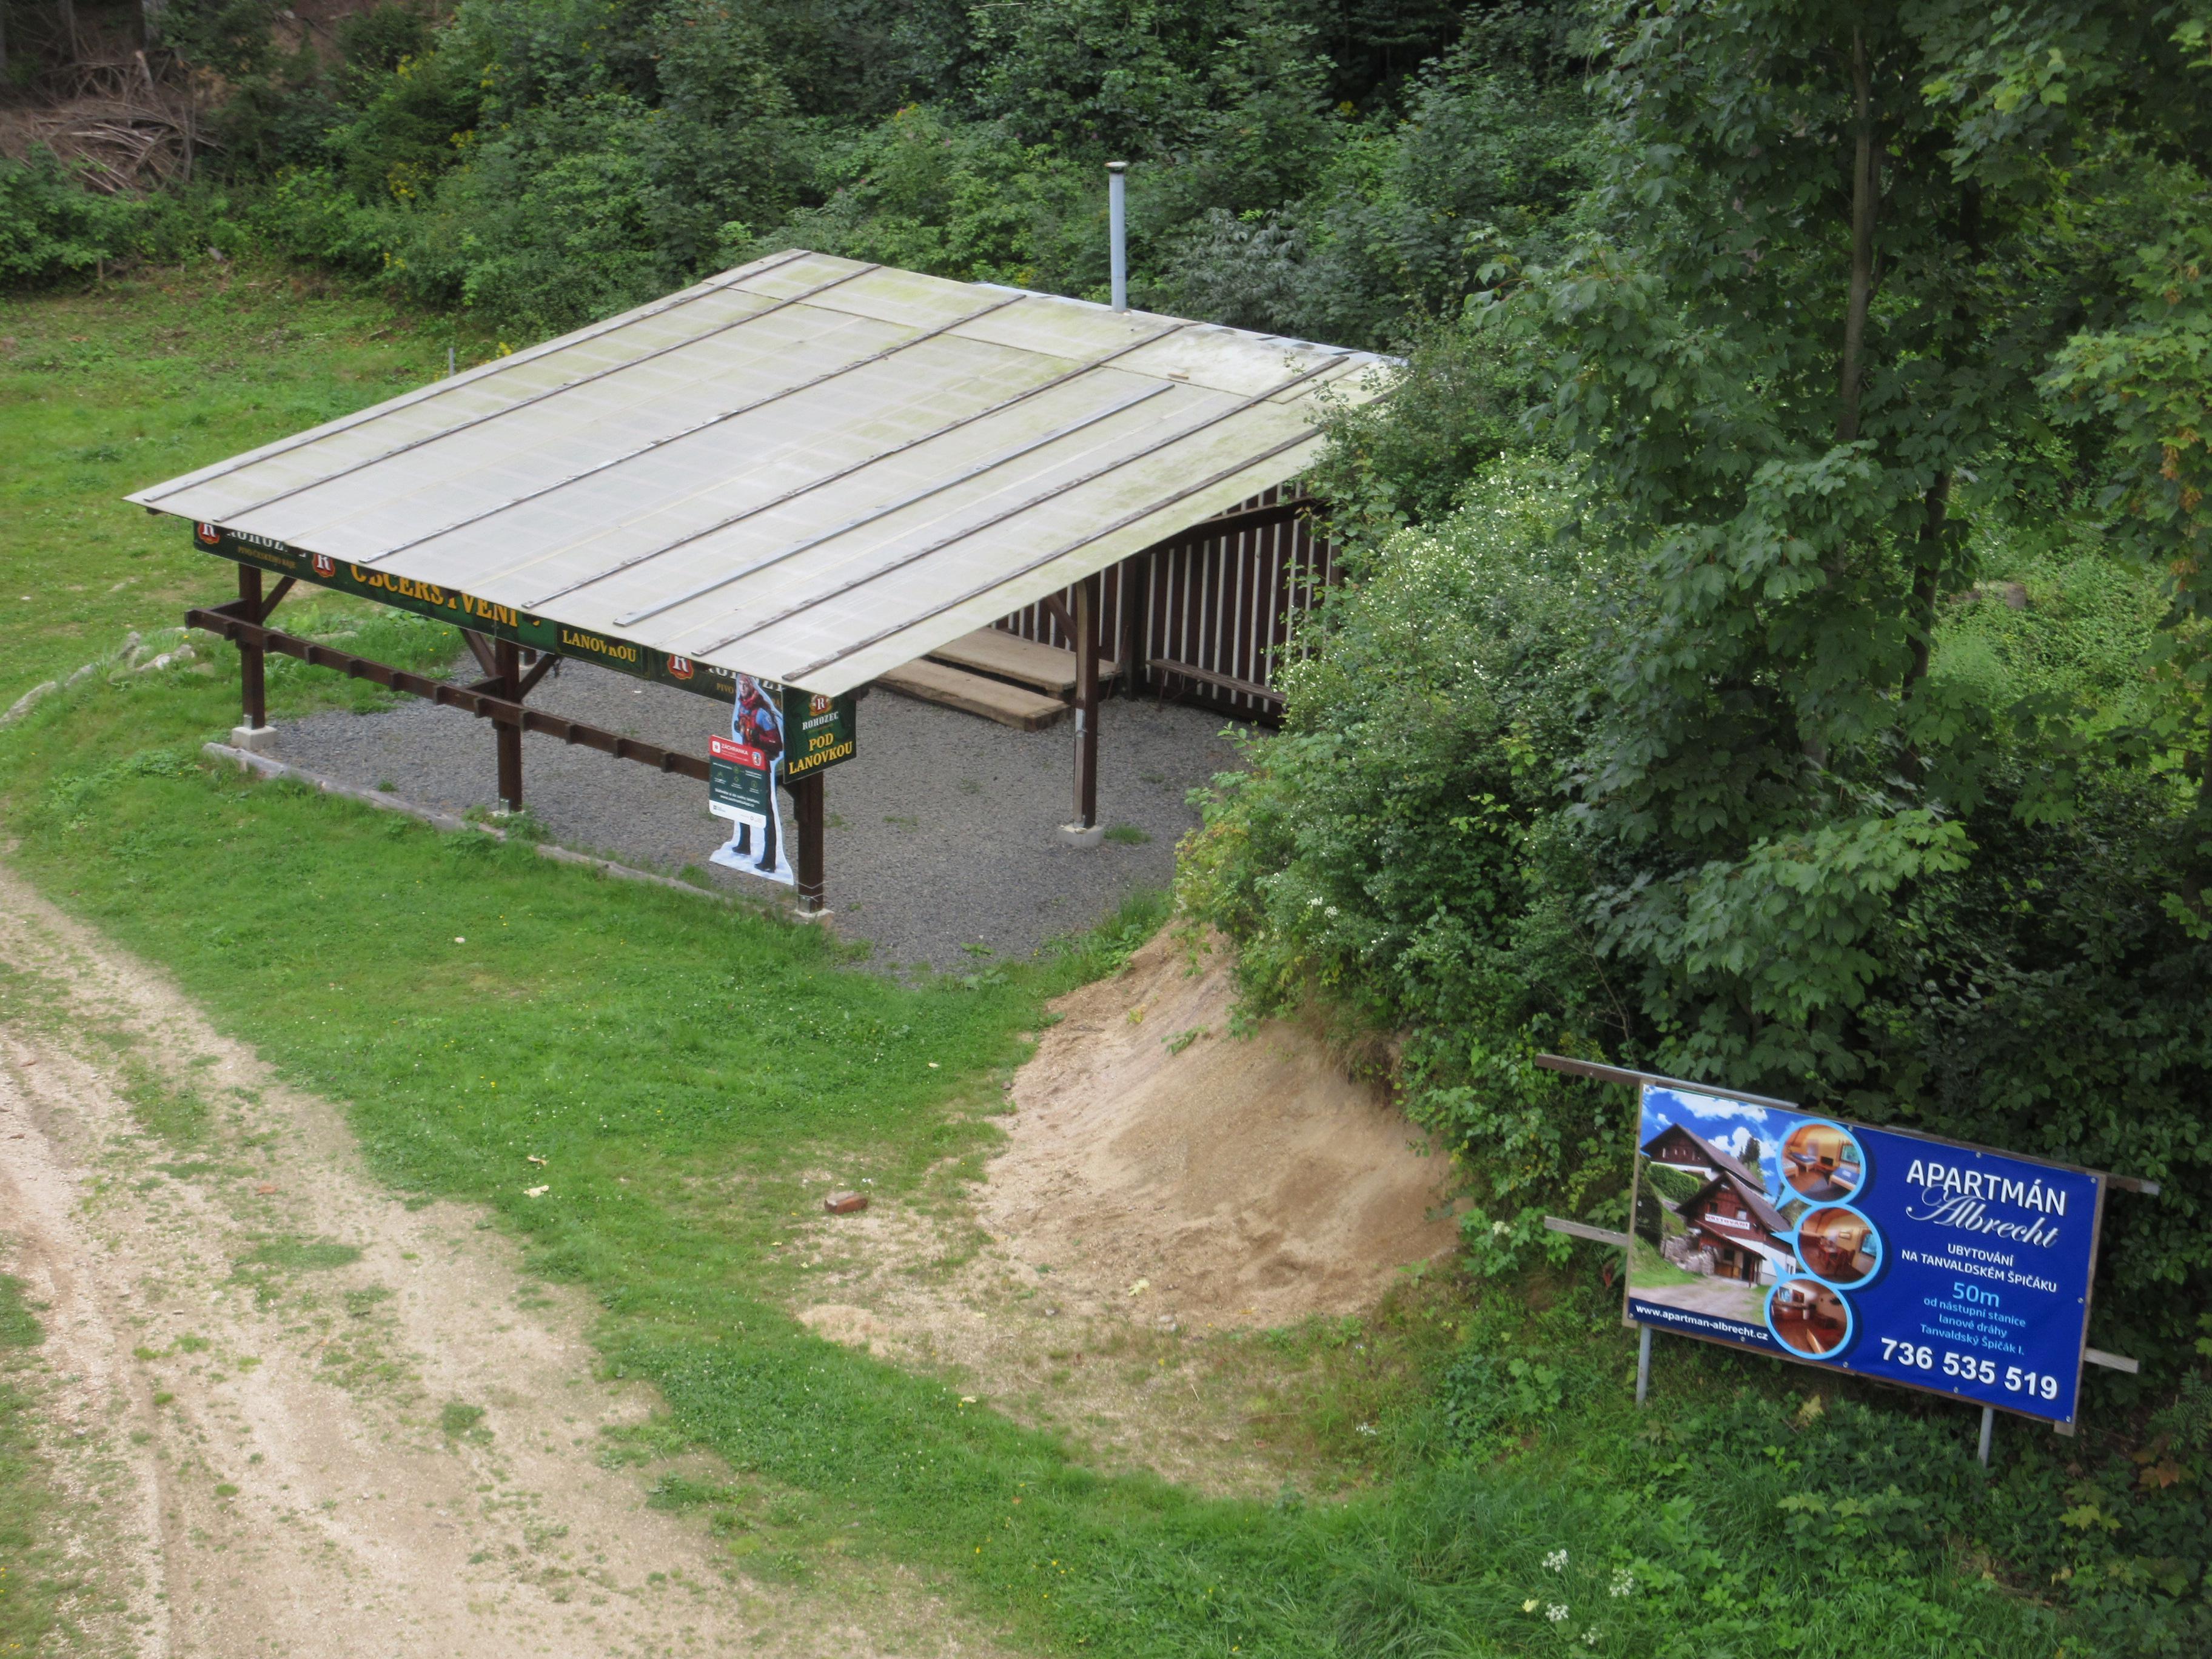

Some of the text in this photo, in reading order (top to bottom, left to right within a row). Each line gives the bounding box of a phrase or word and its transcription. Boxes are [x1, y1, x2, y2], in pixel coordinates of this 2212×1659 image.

[816, 697, 826, 711] R
[802, 711, 839, 731] ROHOZEC
[788, 740, 853, 775] LANOVKOU
[808, 732, 834, 752] POD
[1906, 1159, 2066, 1217] APARTMÁN
[1905, 1183, 2059, 1248] Albrecht
[1901, 1248, 2057, 1293] NA TANVALDSKÉM ŠPIČÁKU
[1947, 1243, 2014, 1267] UBYTOVÁNÍ
[1952, 1281, 2000, 1308] 50m
[1635, 1304, 1769, 1341] www.apartman-albrecht.cz
[1923, 1297, 2026, 1328] od nástupní stanice
[1939, 1313, 2008, 1339] lanové dráhy
[1920, 1322, 1979, 1347] Tanvaldský
[1981, 1335, 2017, 1354] Špičák
[1880, 1336, 2058, 1401] 736 535 519
